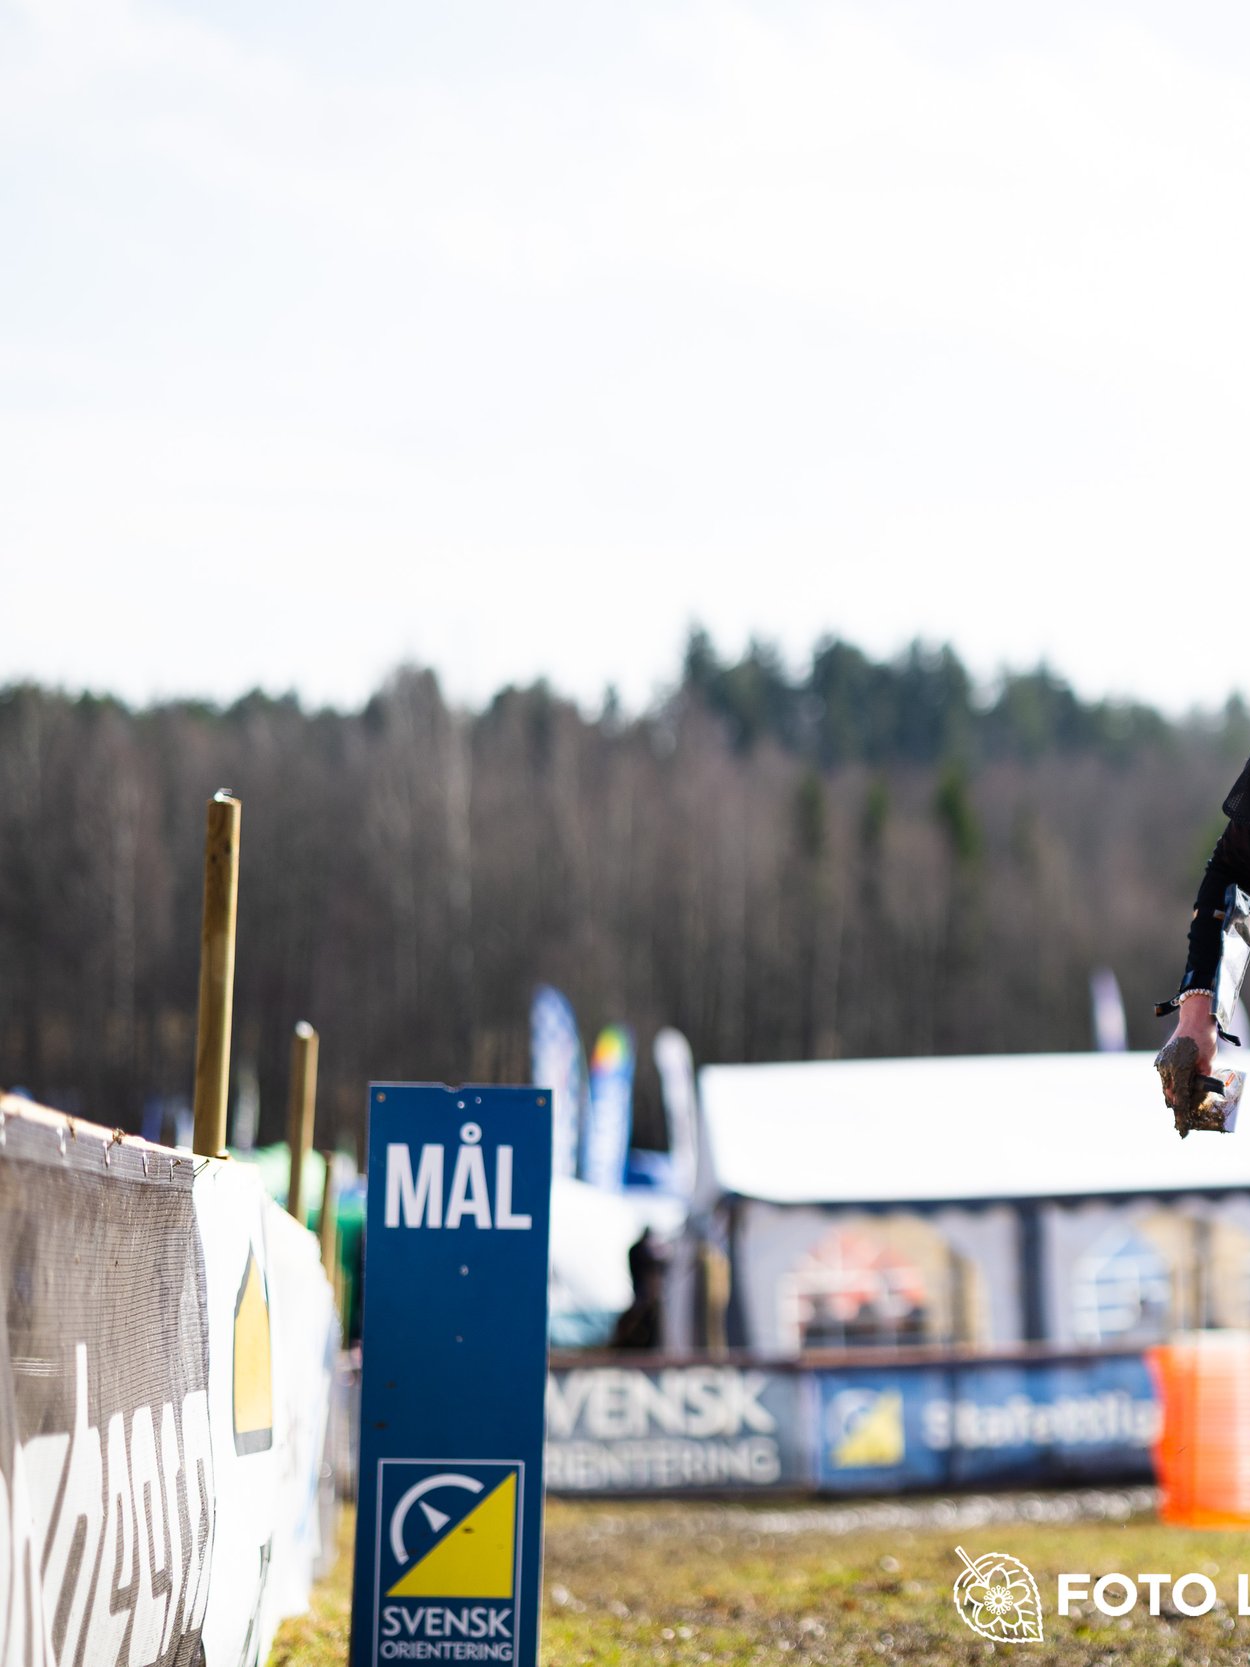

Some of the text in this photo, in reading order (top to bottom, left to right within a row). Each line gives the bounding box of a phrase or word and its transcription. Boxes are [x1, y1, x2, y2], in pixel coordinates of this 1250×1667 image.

[384, 1121, 532, 1230] MÅL
[544, 1366, 777, 1440] VENSK
[544, 1435, 782, 1490] RIENTERING
[381, 1606, 514, 1639] SVENSK
[379, 1639, 514, 1663] ORIENTERING
